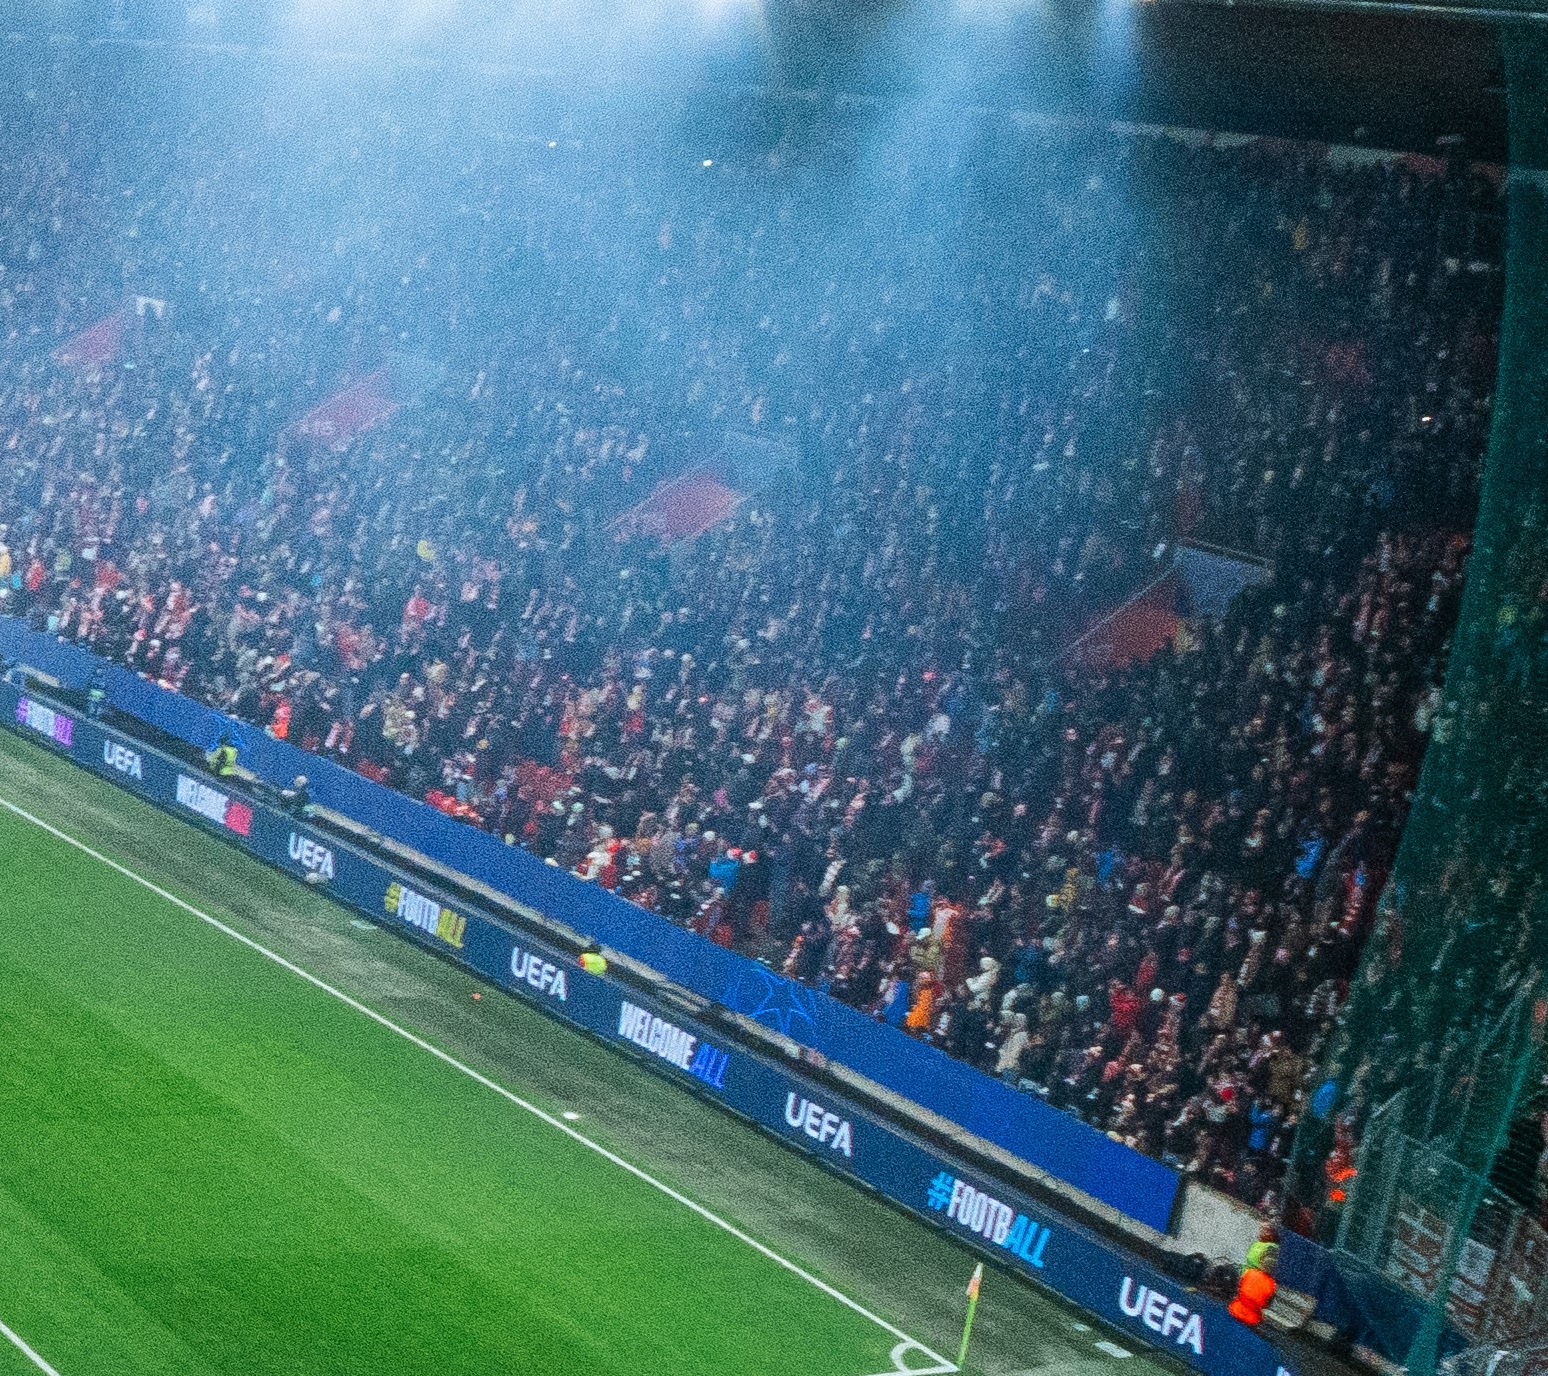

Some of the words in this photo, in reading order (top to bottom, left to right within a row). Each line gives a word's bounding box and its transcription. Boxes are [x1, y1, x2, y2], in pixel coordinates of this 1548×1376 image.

[104, 739, 143, 781] UEFA
[289, 832, 335, 880] UEFA
[511, 947, 567, 1002] UEFA
[785, 1092, 854, 1158] UEFA
[927, 1171, 1053, 1270] #FOOTBALL
[1119, 1277, 1205, 1356] UEFA
